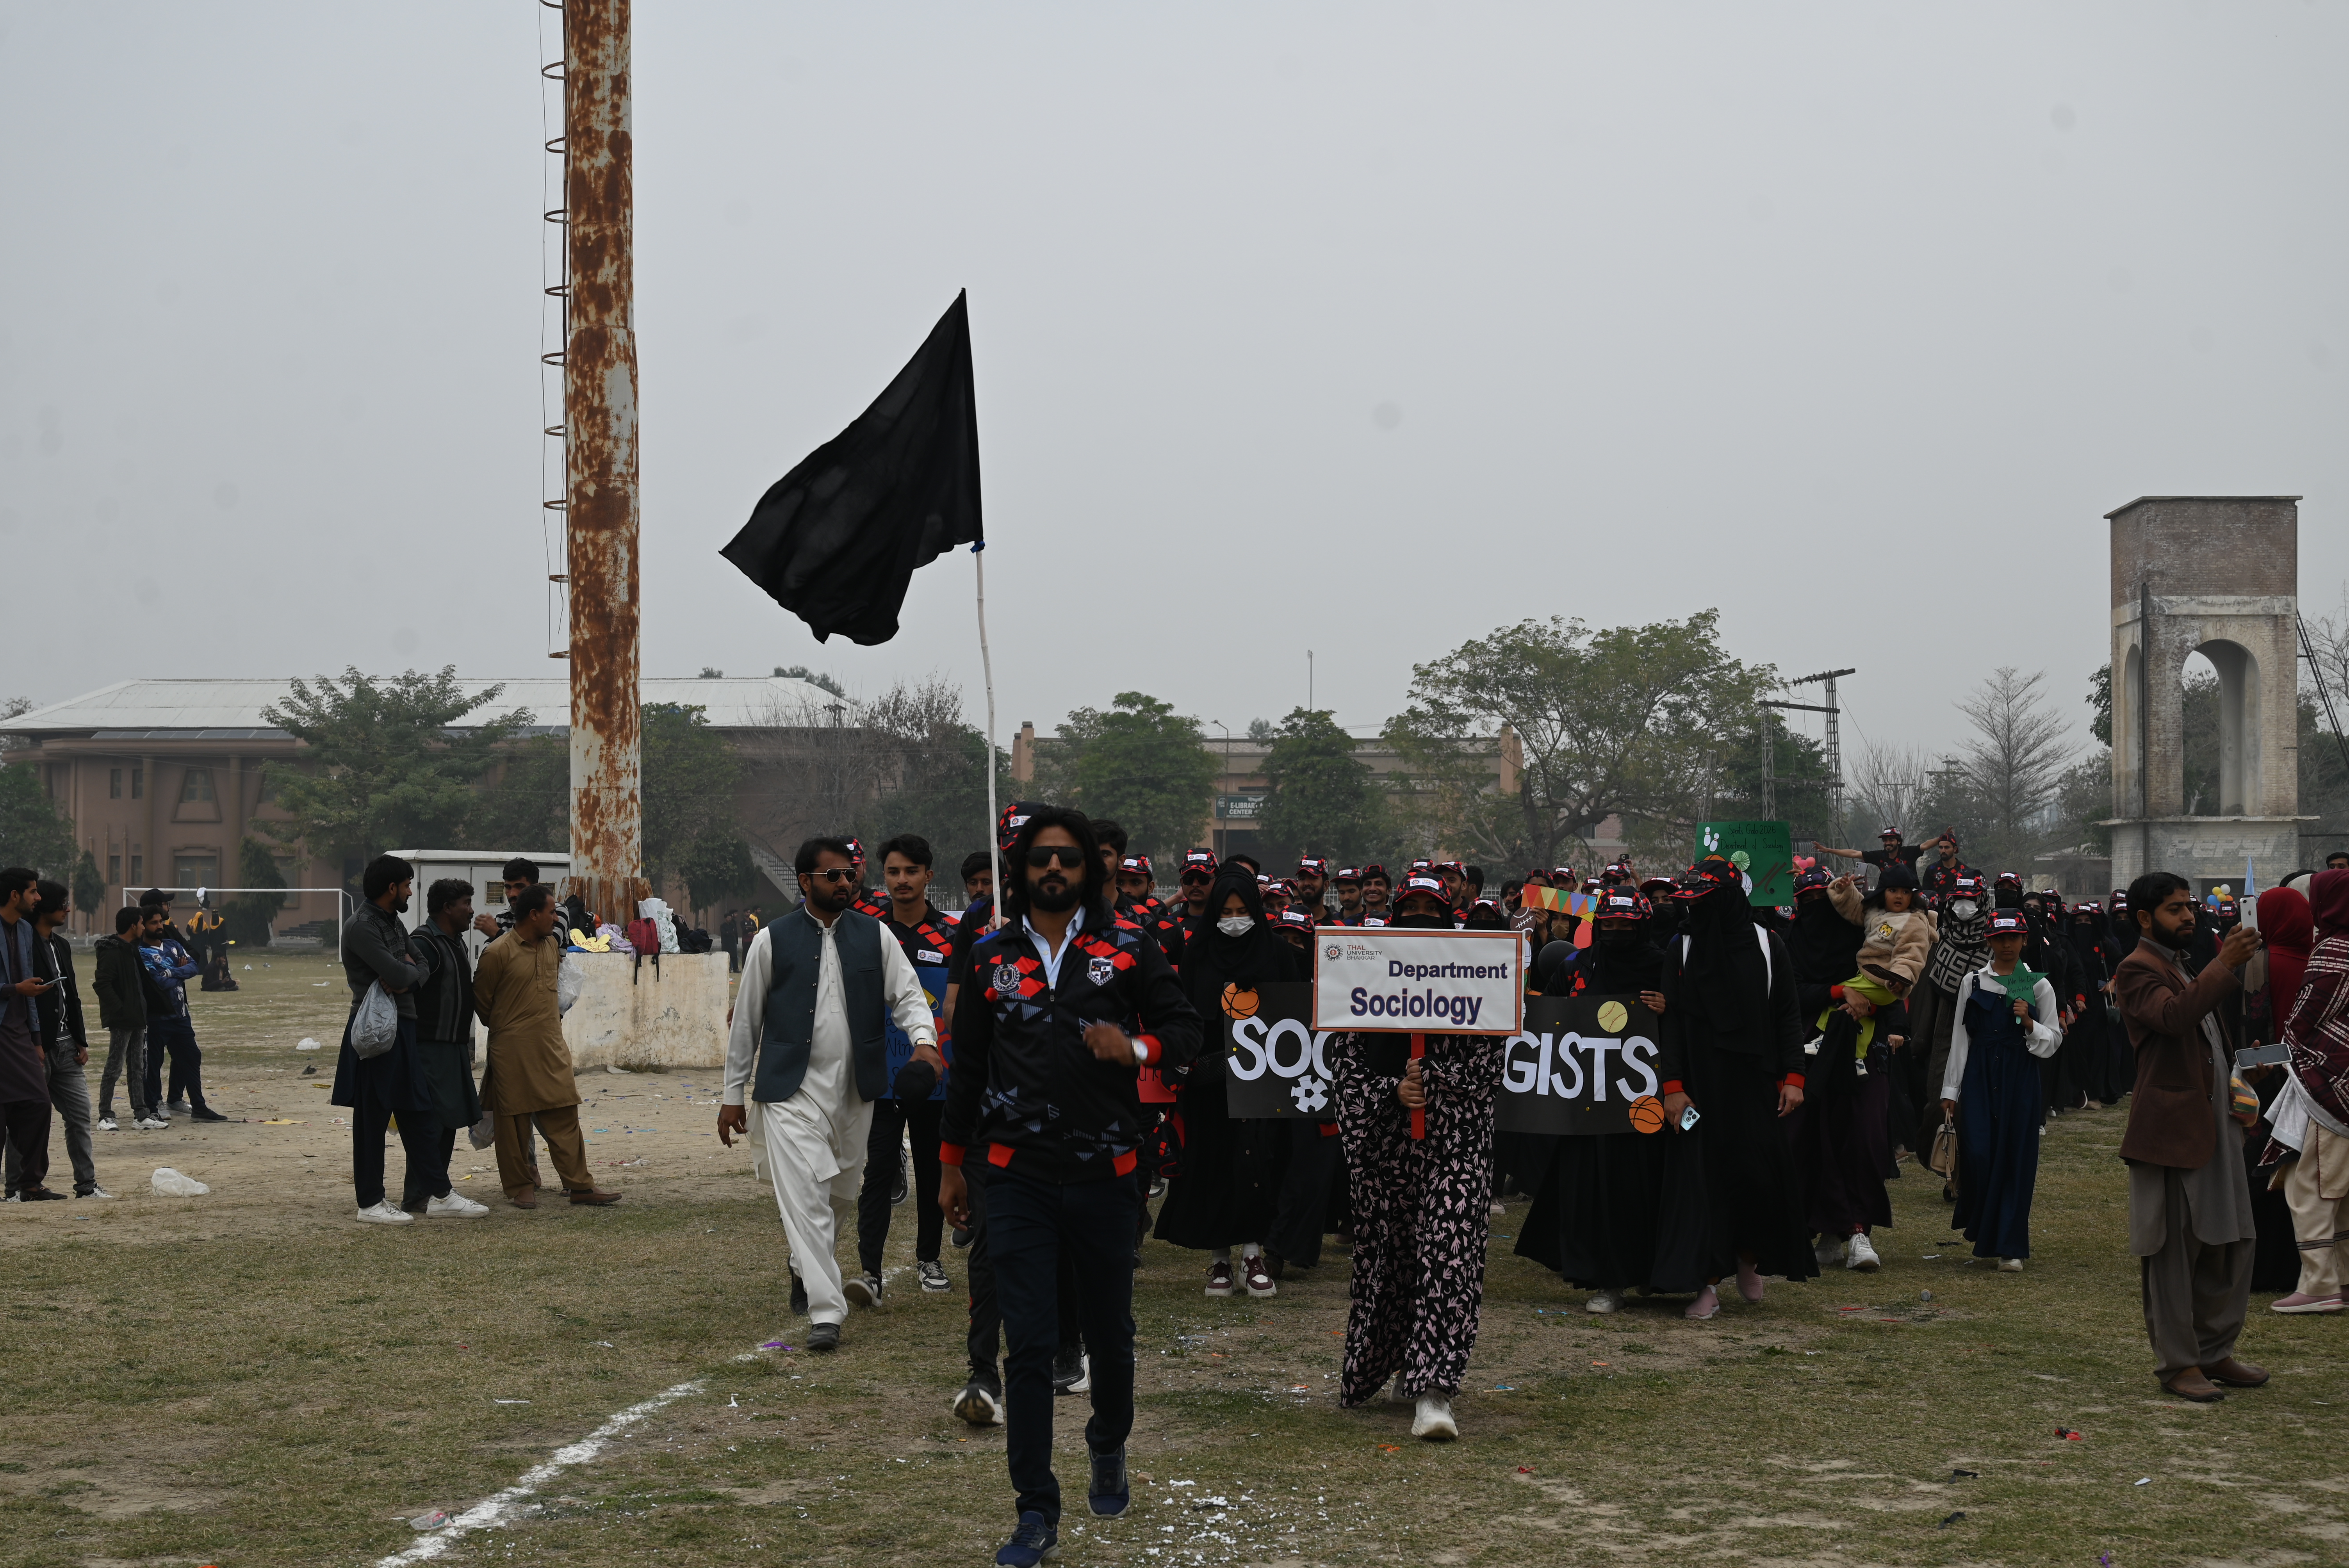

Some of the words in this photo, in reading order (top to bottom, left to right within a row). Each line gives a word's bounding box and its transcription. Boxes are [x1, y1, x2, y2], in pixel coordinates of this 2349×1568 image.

[1728, 823, 1743, 837] Sports
[1760, 825, 1776, 834] 2026
[1721, 838, 1747, 852] Department
[1752, 839, 1757, 852] of
[1763, 838, 1783, 852] Sociology
[2168, 834, 2276, 857] PEPSI
[1388, 960, 1508, 981] Department
[2027, 975, 2037, 984] Day!
[1350, 987, 1483, 1026] Sociology
